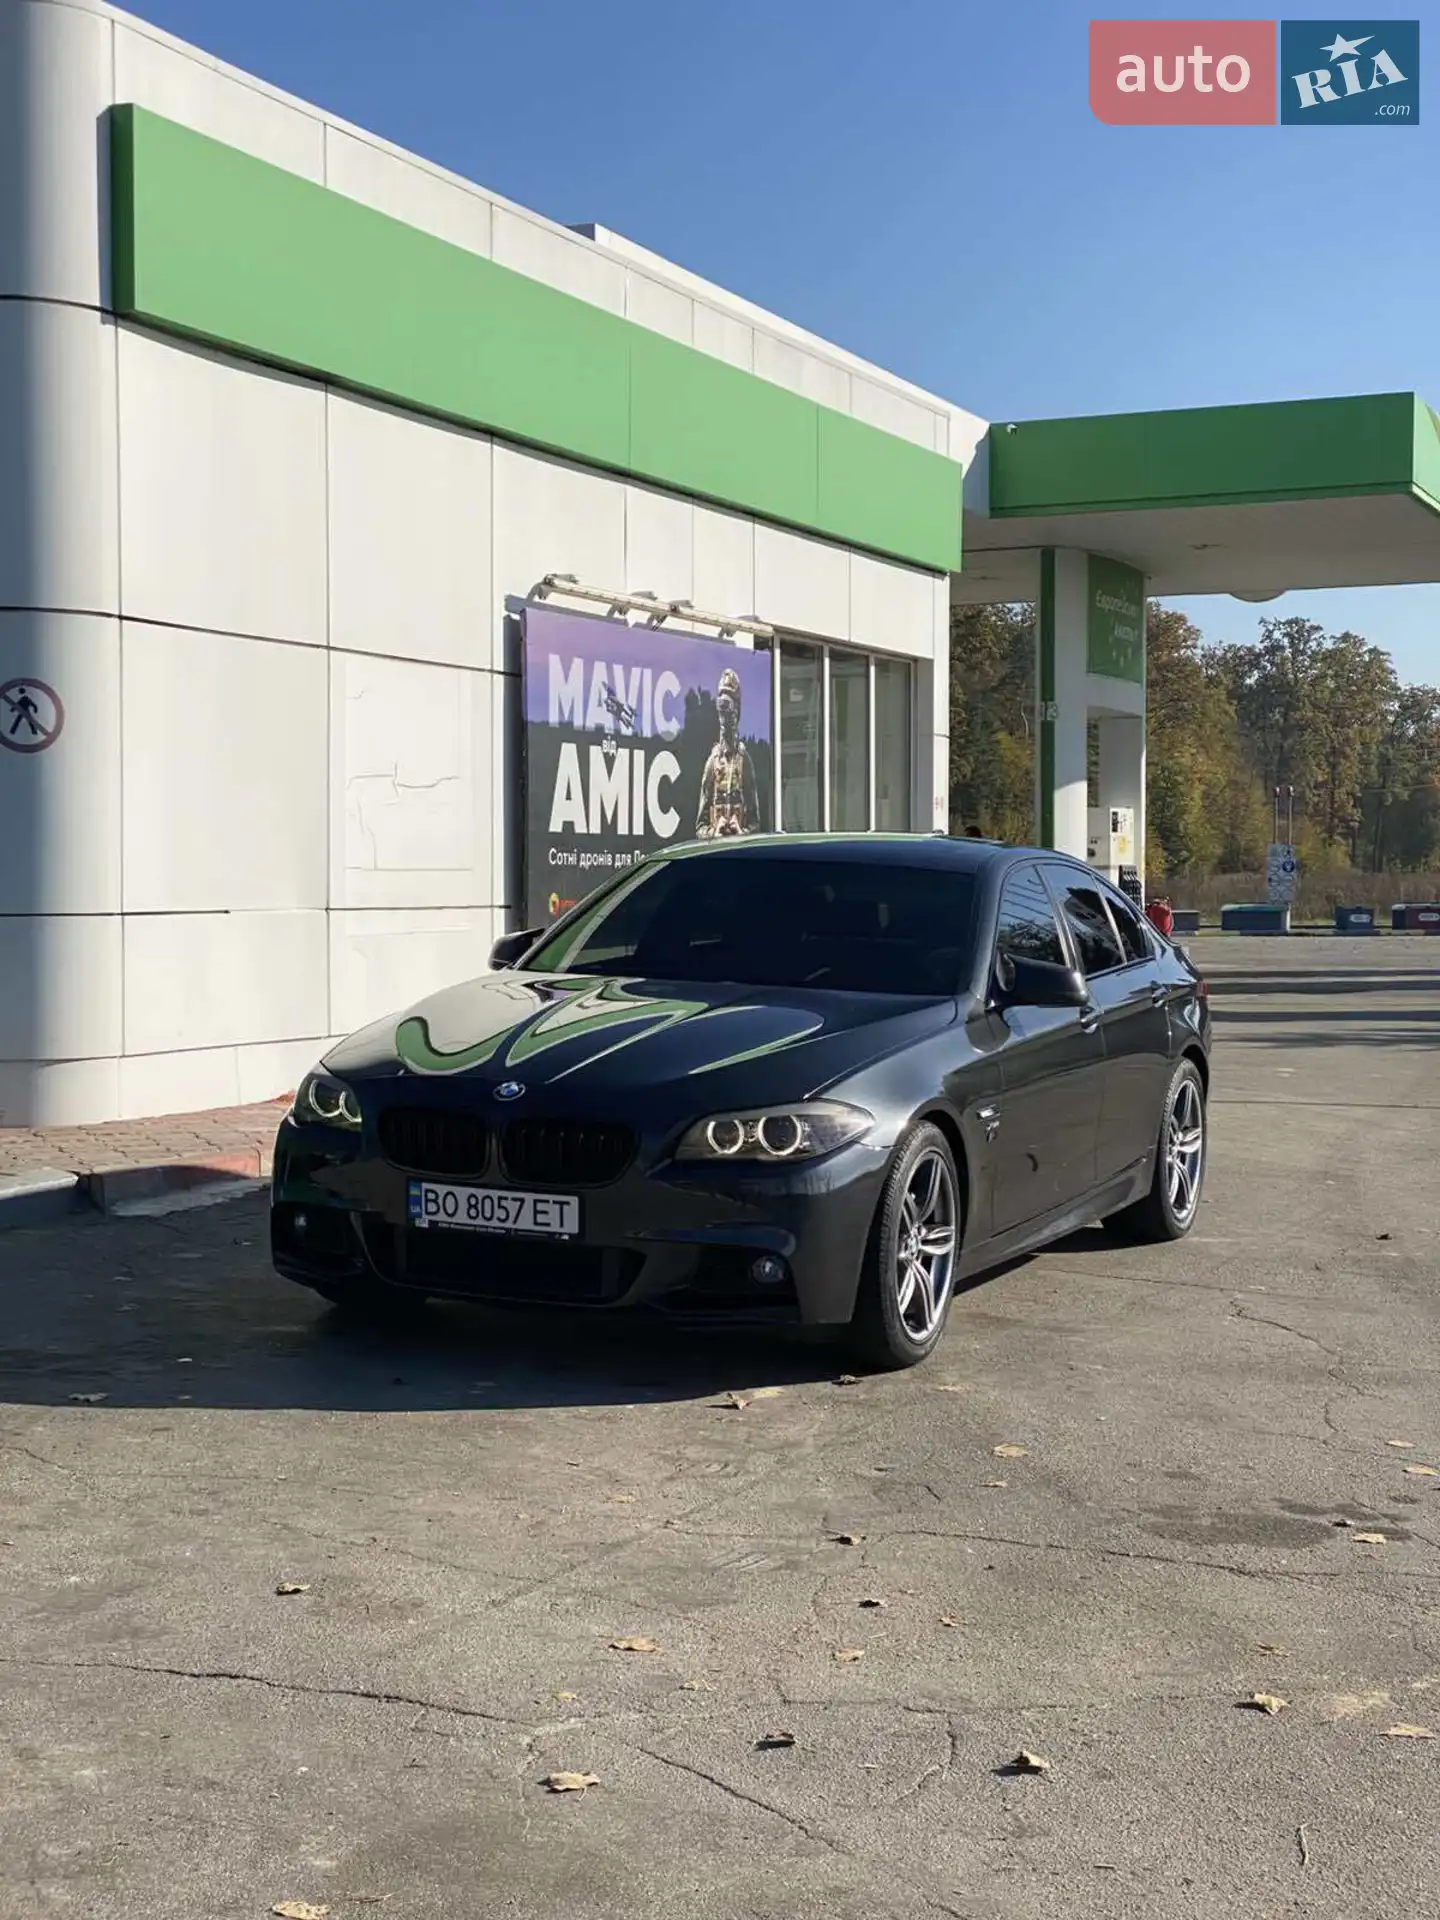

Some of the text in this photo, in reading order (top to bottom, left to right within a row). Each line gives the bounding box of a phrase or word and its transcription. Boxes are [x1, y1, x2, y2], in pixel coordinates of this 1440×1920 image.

[548, 654, 681, 742] MAVIC
[548, 742, 681, 838] AMIC
[548, 847, 577, 866] Сотні
[579, 849, 613, 870] дронів
[614, 853, 632, 869] для
[424, 1188, 459, 1218] BO
[466, 1193, 526, 1226] 8057
[533, 1198, 571, 1229] ET
